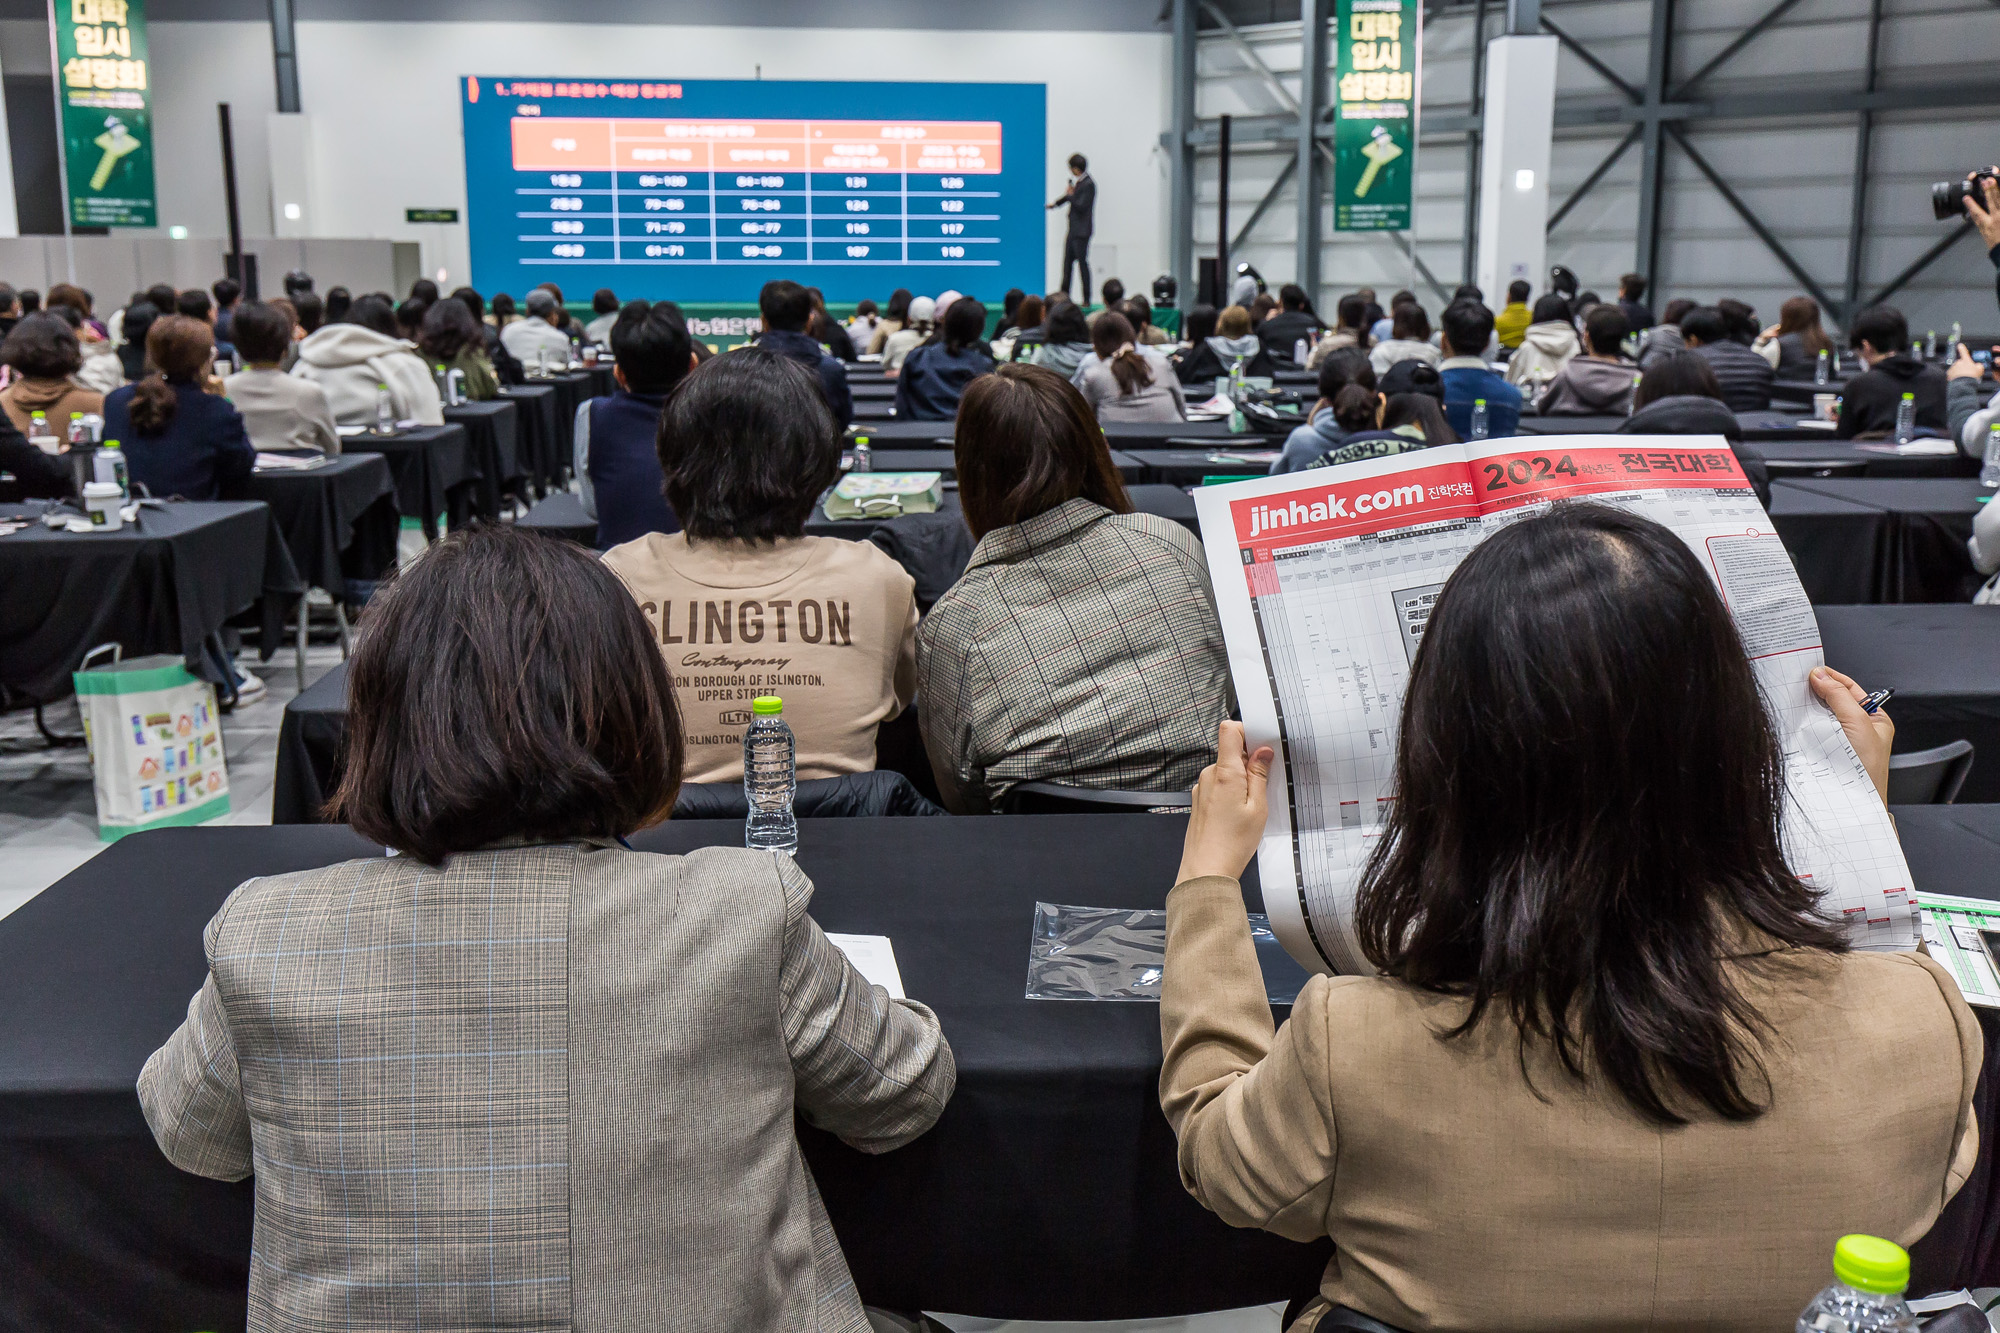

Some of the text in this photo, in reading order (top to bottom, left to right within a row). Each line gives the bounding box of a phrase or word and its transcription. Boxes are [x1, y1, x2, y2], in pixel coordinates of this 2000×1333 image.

[74, 26, 131, 57] 입시
[1350, 13, 1402, 41] 대학
[1350, 41, 1401, 71] 입시
[63, 57, 147, 90] 설명회
[1339, 71, 1412, 101] 설명회
[1483, 452, 1735, 491] 2024 학년도 전국대학
[1250, 483, 1424, 537] jinhak.com
[1427, 481, 1474, 501] 진학닷컴
[681, 652, 792, 671] Contemporary
[673, 674, 825, 687] ON BOROUGH OF ISLINGTON,
[698, 689, 733, 701] UPPER
[686, 734, 740, 745] ISLINGTON
